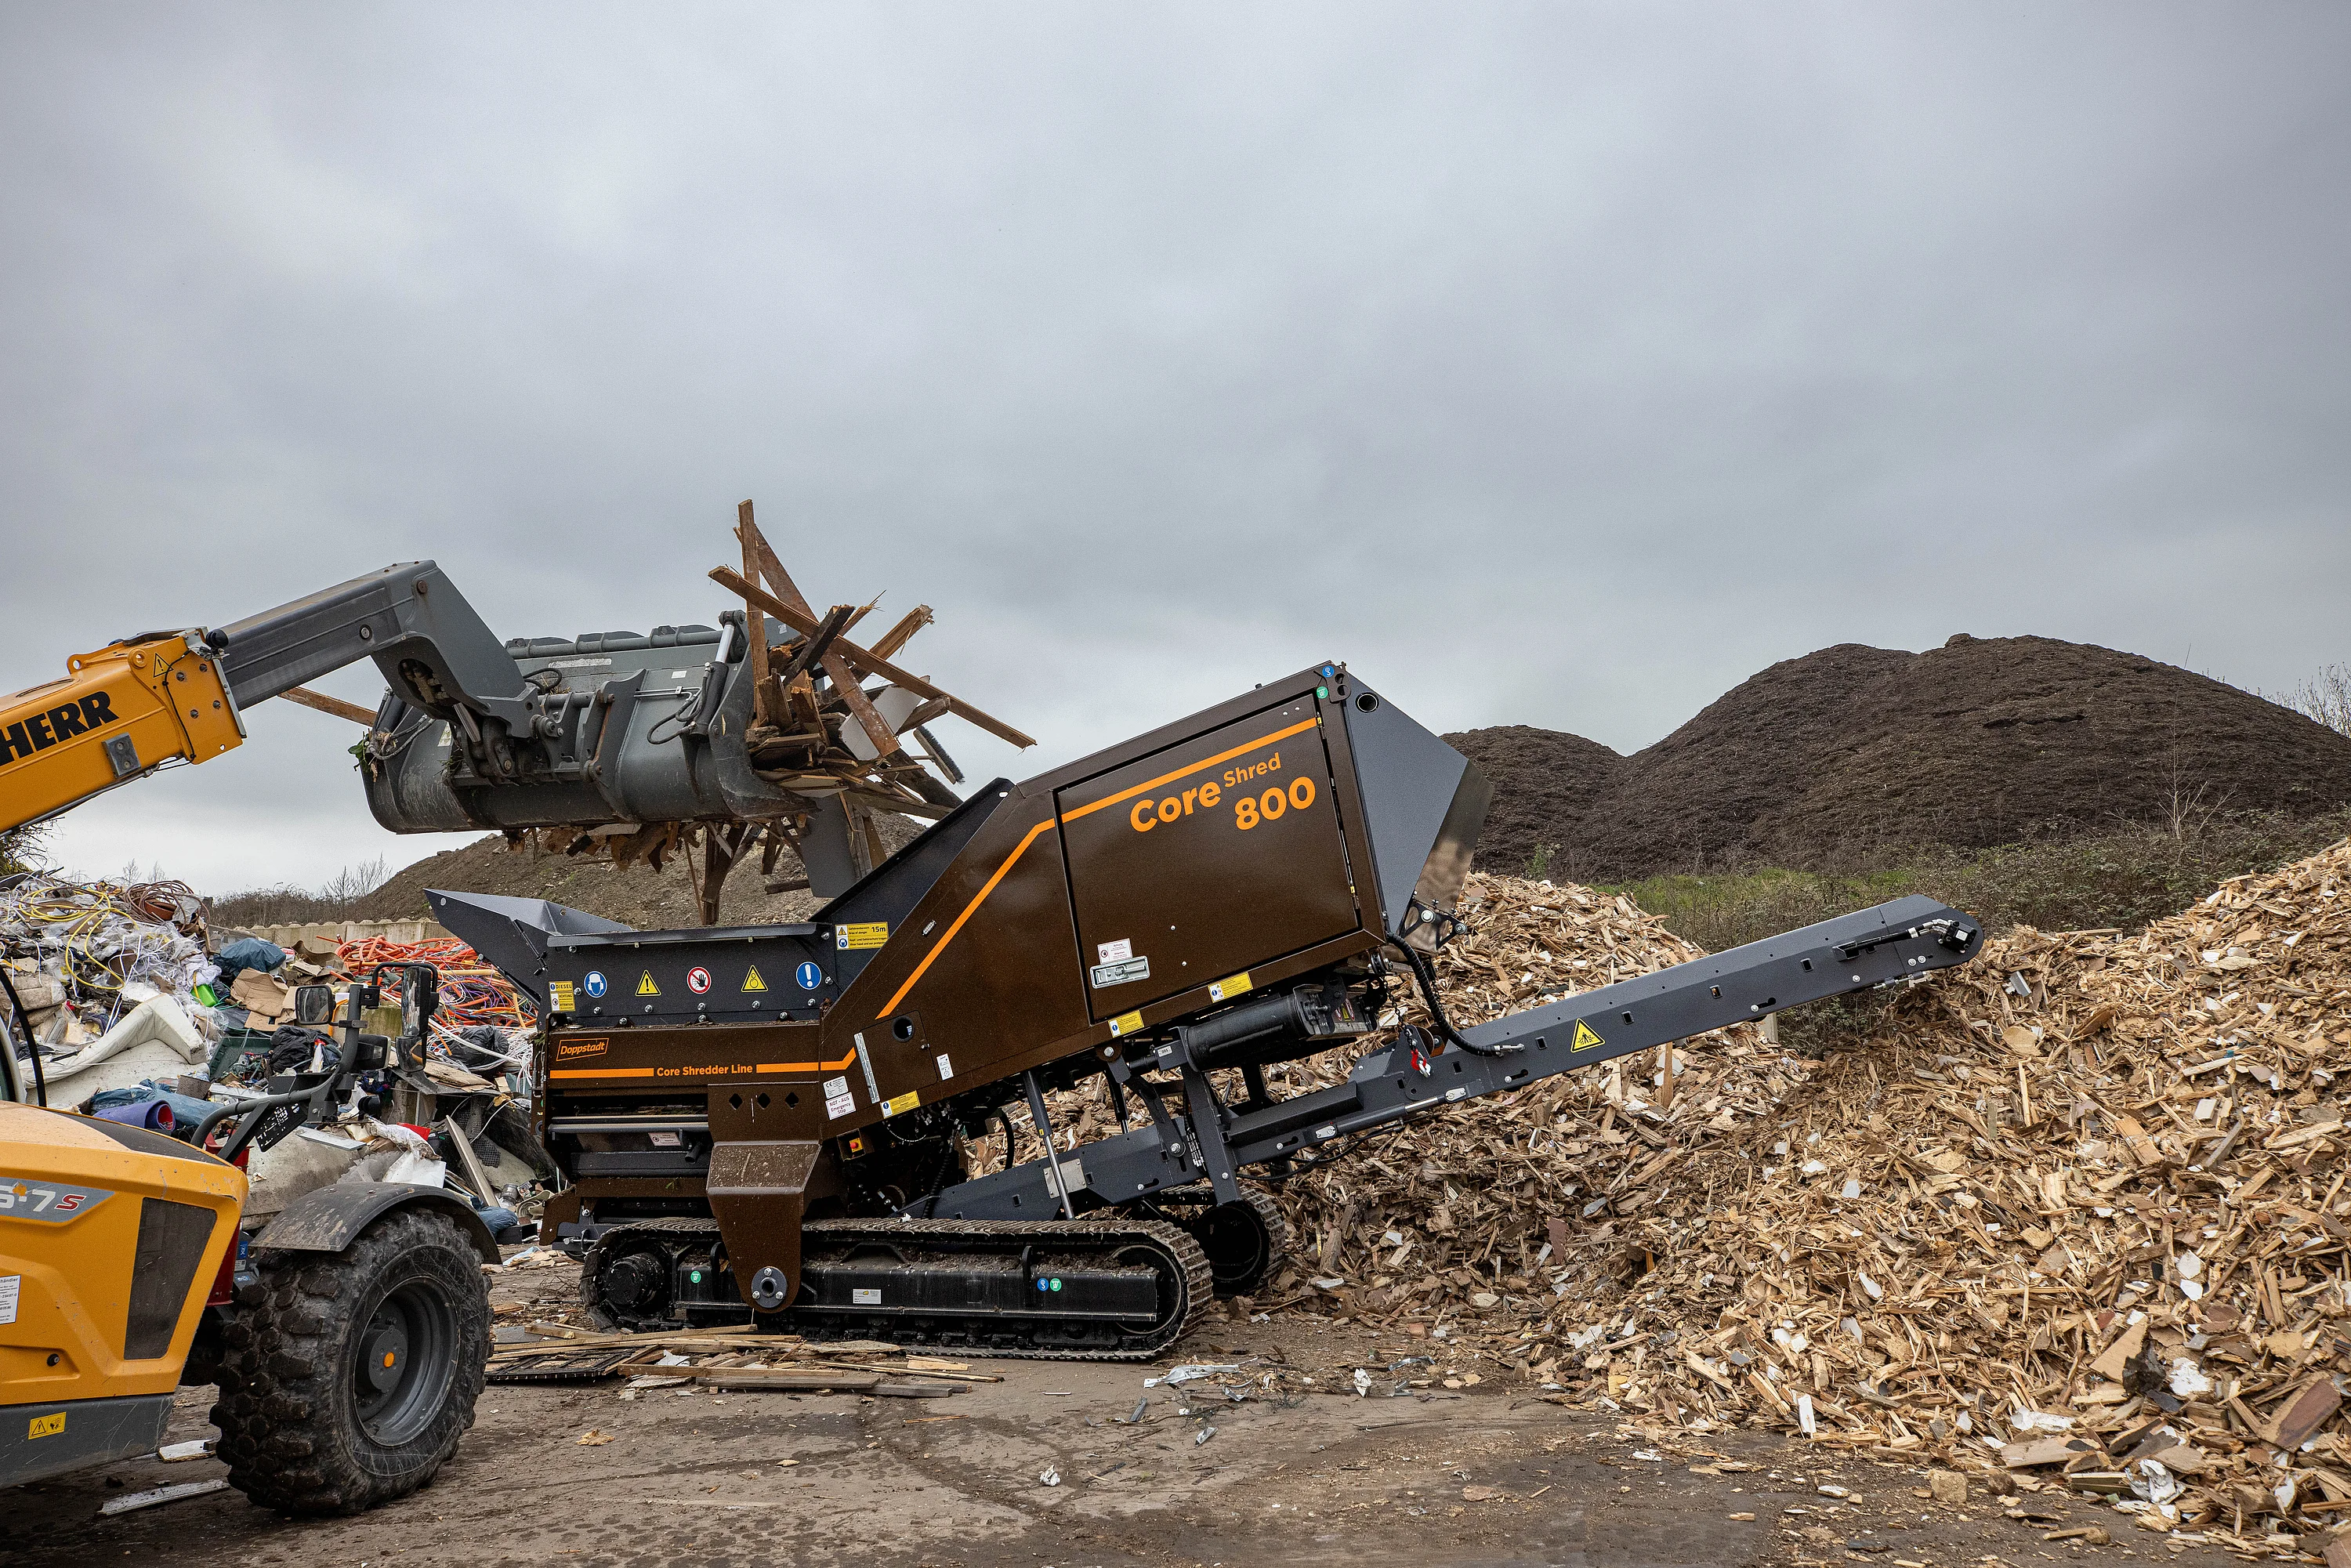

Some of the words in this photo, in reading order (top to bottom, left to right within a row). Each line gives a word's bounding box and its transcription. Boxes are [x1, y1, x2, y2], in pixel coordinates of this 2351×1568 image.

[0, 691, 119, 766] HERR
[1130, 781, 1221, 832] Core
[1223, 752, 1281, 788] Shred
[1234, 777, 1316, 831] 800
[560, 1041, 606, 1056] Doppstadt
[657, 1067, 680, 1077] Core
[682, 1065, 729, 1076] Shredder
[731, 1064, 753, 1074] Line
[831, 1103, 851, 1112] Emergency
